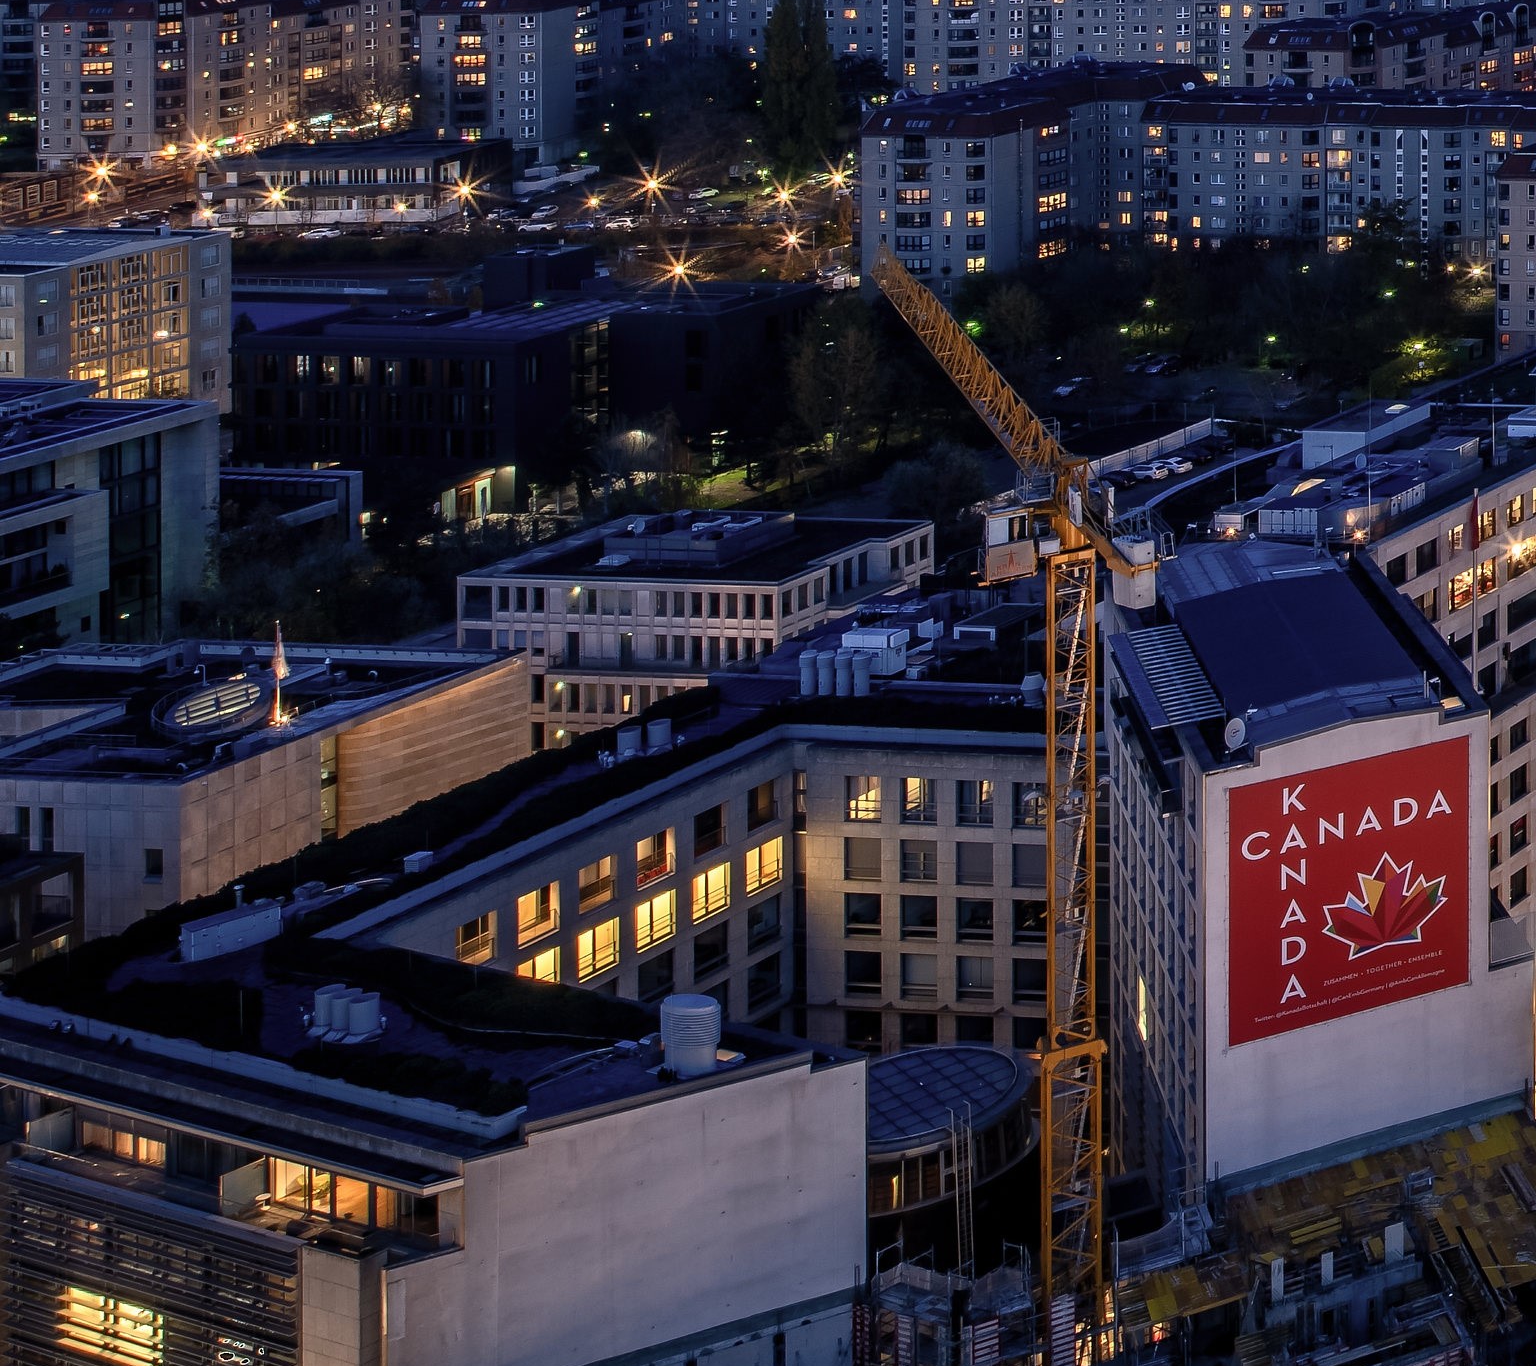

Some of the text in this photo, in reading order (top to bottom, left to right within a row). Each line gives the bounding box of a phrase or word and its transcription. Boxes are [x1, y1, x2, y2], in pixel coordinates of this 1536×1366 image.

[1241, 789, 1453, 861] CANADA
[1280, 783, 1307, 1004] KANADA
[1323, 949, 1443, 987] ZUSAMMEN TOGETHER ENSEMBLE
